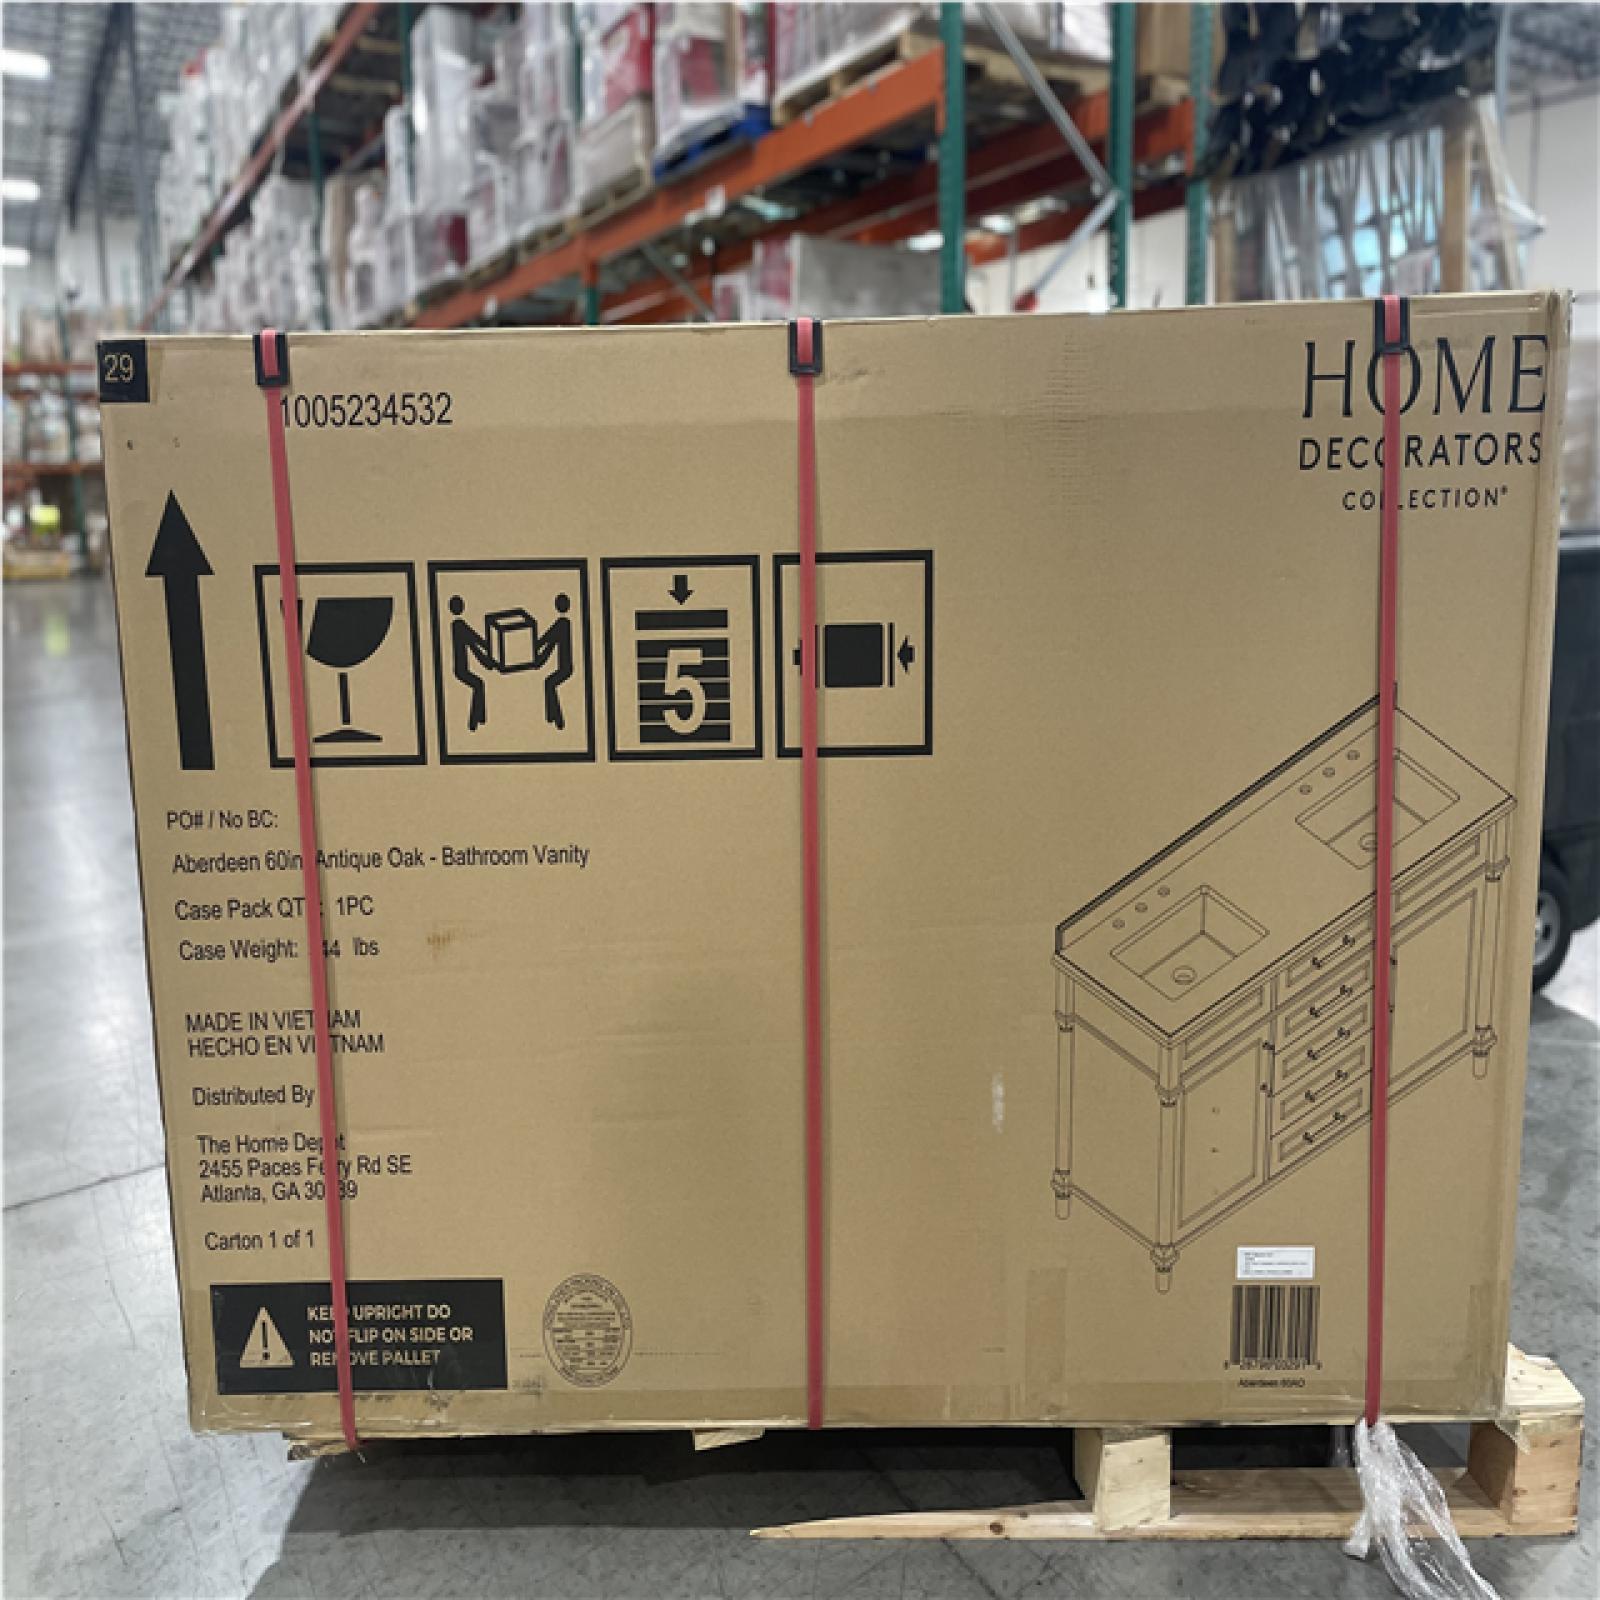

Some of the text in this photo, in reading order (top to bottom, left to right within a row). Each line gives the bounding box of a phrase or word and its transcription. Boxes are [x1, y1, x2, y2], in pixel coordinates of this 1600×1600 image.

[104, 353, 134, 383] 29
[1302, 335, 1547, 418] HOME
[280, 391, 453, 428] 1005234532
[166, 809, 279, 830] PO# / No BC:
[173, 852, 261, 873] Aberdeen
[316, 848, 383, 872] Antique
[387, 846, 425, 868] Oak
[441, 845, 528, 867] Bathroom
[533, 843, 590, 868] Vanity
[175, 894, 374, 920] Case Pack QT: 1PC
[180, 939, 226, 960] Case
[230, 937, 299, 963] Weight:
[353, 936, 380, 956] lbs
[186, 1009, 361, 1032] MADE IN VIETAM
[188, 1034, 385, 1057] HECHO EN VITNAM
[192, 1083, 315, 1107] Distributed By
[197, 1134, 231, 1155] The
[236, 1133, 288, 1153] Home
[199, 1159, 243, 1178] 2455
[247, 1156, 302, 1177] Paces
[356, 1154, 381, 1175] Rd
[386, 1153, 413, 1174] SE
[201, 1179, 358, 1204] Atlanta, GA 3039
[204, 1229, 315, 1251] Carton 1 of 1
[352, 1304, 423, 1321] UPRIGHT
[426, 1303, 451, 1321] DO
[309, 1328, 342, 1344] NO
[381, 1327, 406, 1343] ON
[409, 1326, 446, 1342] SIDE
[449, 1326, 474, 1342] OR
[381, 1349, 441, 1366] PALLET
